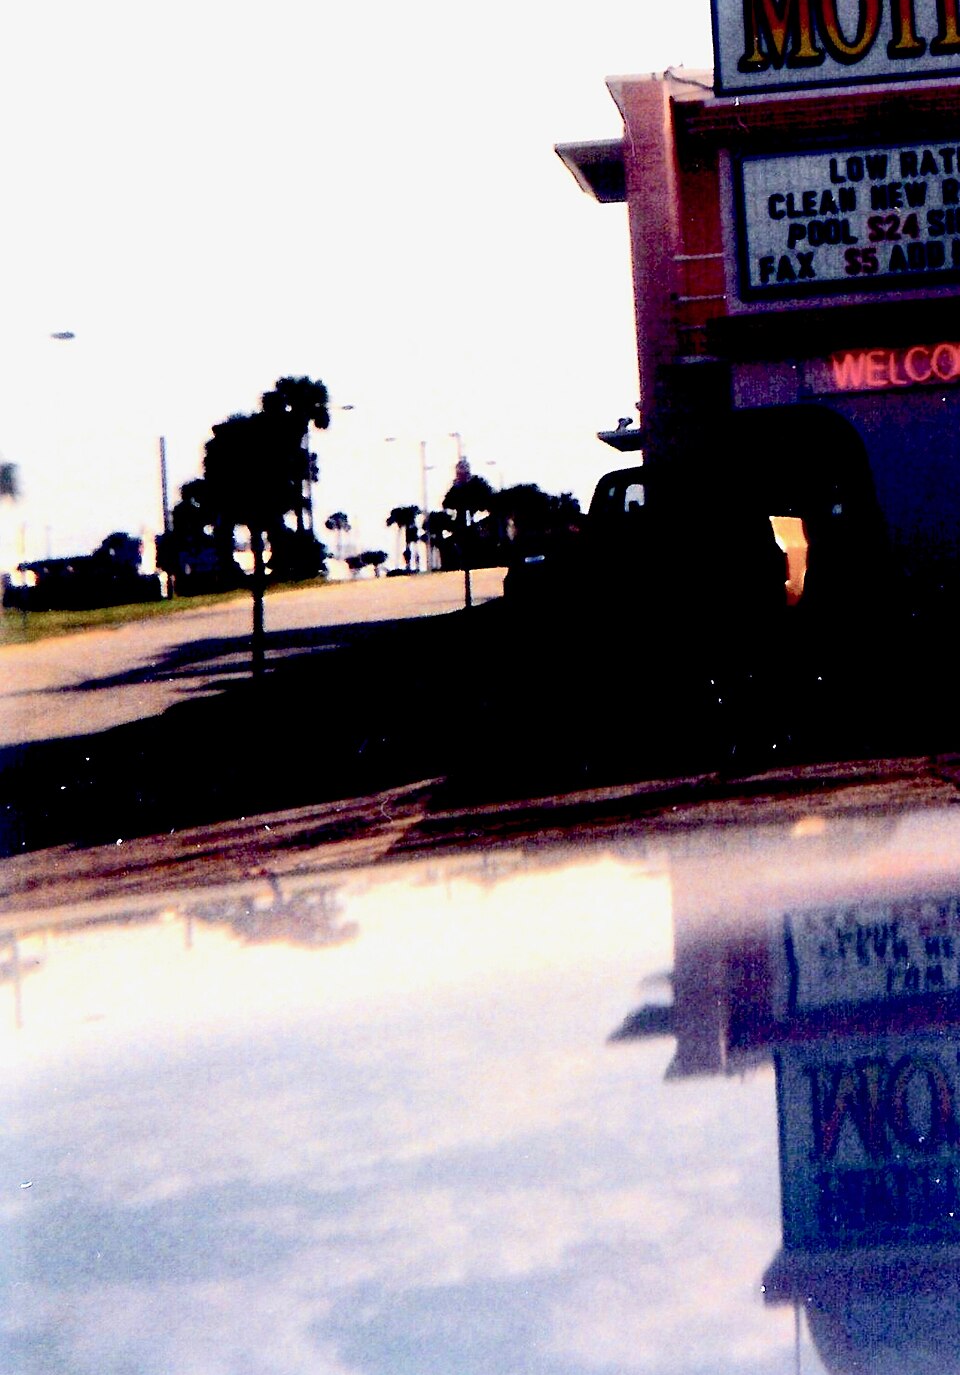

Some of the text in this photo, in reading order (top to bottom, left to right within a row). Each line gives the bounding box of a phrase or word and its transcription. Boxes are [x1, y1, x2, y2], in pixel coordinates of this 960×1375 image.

[829, 154, 888, 183] LOW
[768, 187, 856, 220] CLEAN
[870, 181, 927, 210] NEW
[787, 218, 858, 249] POOL
[759, 252, 816, 284] FAX
[889, 240, 945, 272] ADD
